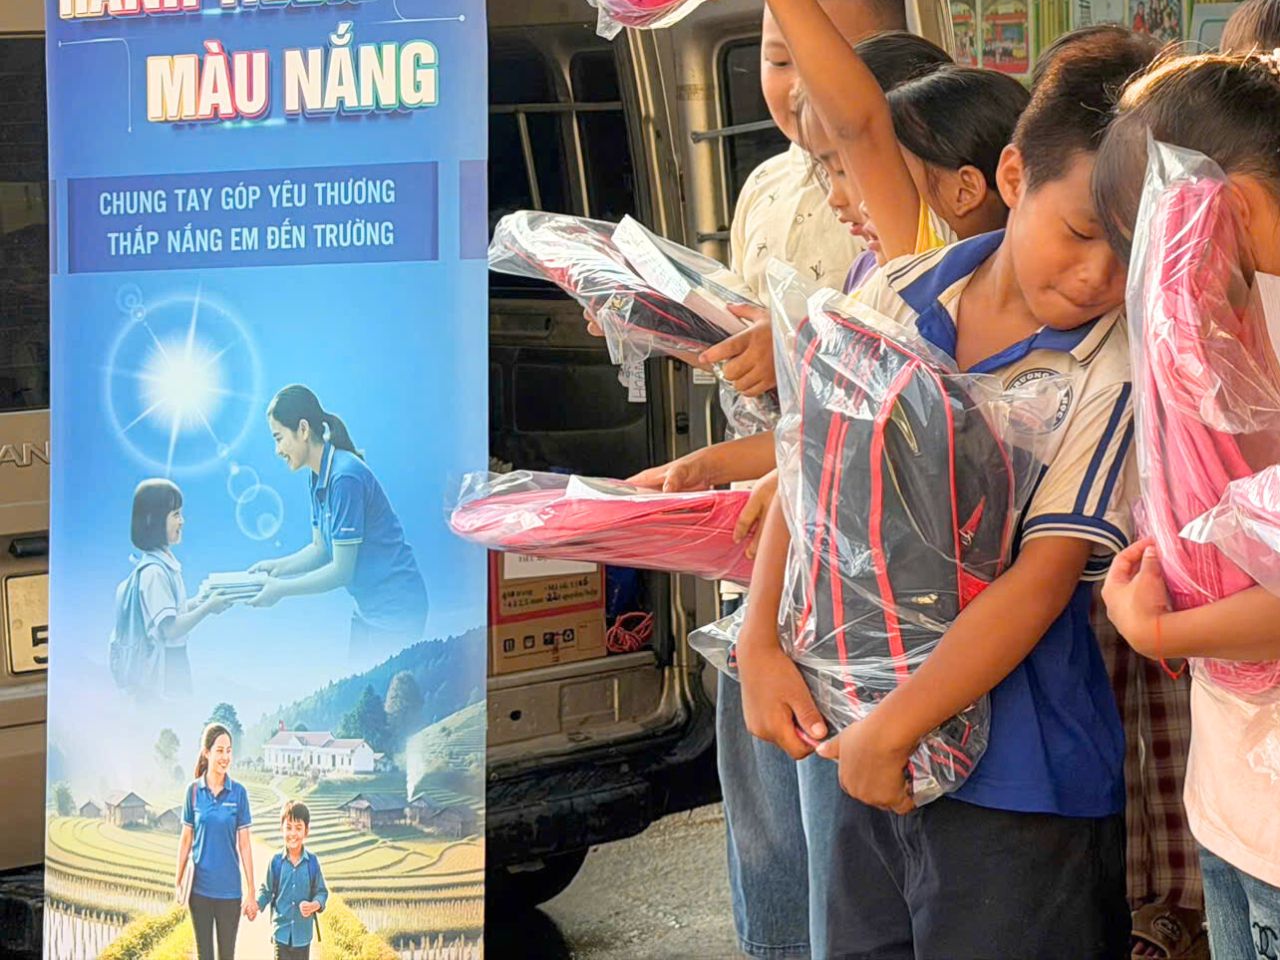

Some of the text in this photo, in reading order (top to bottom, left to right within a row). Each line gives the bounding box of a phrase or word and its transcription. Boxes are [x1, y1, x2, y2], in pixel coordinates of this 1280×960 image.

[146, 21, 440, 123] MÀU NẮNG
[99, 177, 396, 216] CHUNG TAY GÓP YÊU THƯƠNG
[107, 217, 395, 256] THẮP NẮNG EM ĐẾN TRƯỜNG
